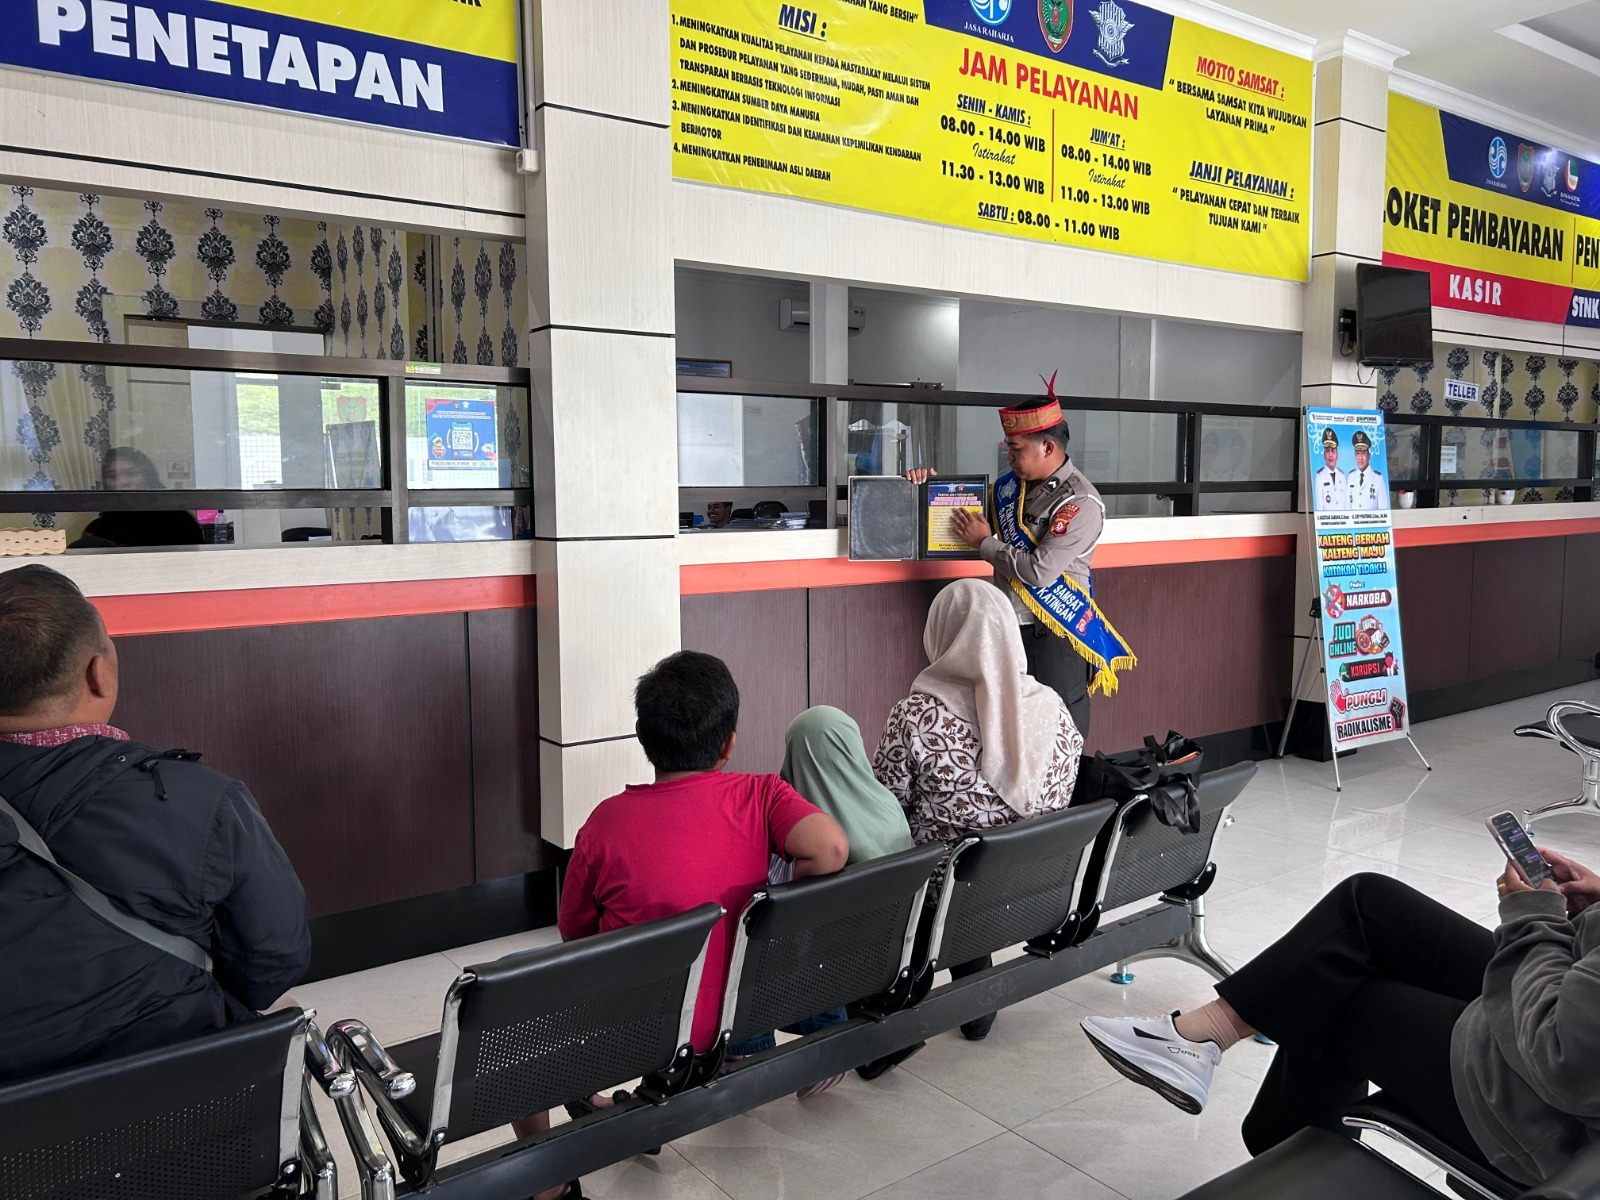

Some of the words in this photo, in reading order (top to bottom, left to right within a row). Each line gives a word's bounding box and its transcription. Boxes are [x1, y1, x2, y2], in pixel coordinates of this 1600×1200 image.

[778, 4, 817, 34] MISI
[868, 0, 888, 14] YANG
[964, 22, 981, 33] JASA
[982, 27, 1014, 43] RAHARJA
[37, 0, 444, 112] PENETAPAN
[680, 16, 740, 41] MENINGKATKAN
[742, 33, 773, 50] KUALITAS
[775, 43, 812, 60] PELAYANAN
[814, 54, 839, 69] KEPADA
[840, 60, 881, 80] MASYARAKAT
[883, 71, 908, 86] MELALUI
[910, 78, 930, 91] SISTEM
[680, 38, 696, 52] DAN
[698, 42, 737, 61] PROSEDUR
[739, 52, 778, 72] PELAYANAN
[780, 63, 798, 78] YANG
[800, 69, 840, 90] SEDERHANA,
[842, 80, 866, 96] MUDAH,
[868, 86, 884, 99] PASTI
[886, 91, 904, 104] AMAN
[906, 95, 919, 106] DAN
[680, 59, 729, 79] TRANSPARAN
[731, 72, 763, 88] BERBASIS
[765, 80, 803, 98] TEKNOLOGI
[805, 92, 840, 107] INFORMASI
[958, 48, 1008, 86] JAM
[1016, 63, 1138, 120] PELAYANAN
[1196, 56, 1235, 83] MOTTO
[1237, 70, 1279, 95] SAMSAT
[680, 80, 740, 103] MENINGKATKAN
[742, 94, 769, 110] SUMBER
[771, 101, 788, 114] DAYA
[790, 106, 820, 122] MANUSIA
[957, 94, 986, 113] SENIN
[995, 104, 1025, 124] KAMIS
[1177, 81, 1215, 102] BERSAMA
[1217, 93, 1246, 111] SAMSAT
[1248, 101, 1265, 117] KITA
[1267, 107, 1306, 128] WUJUDKAN
[681, 101, 740, 123] MENINGKATKAN
[743, 114, 786, 133] IDENTIFIKASI
[788, 125, 802, 137] DAN
[804, 128, 840, 145] KEAMANAN
[842, 137, 883, 154] KEPEMILIKAN
[885, 146, 921, 161] KENDARAAN
[681, 122, 722, 140] BERMOTOR
[941, 115, 975, 136] 08.00
[989, 126, 1020, 147] 14.00
[1024, 135, 1045, 152] WIB
[1206, 107, 1241, 128] LAYANAN
[1244, 118, 1268, 134] PRIMA
[682, 143, 741, 164] MENINGKATKAN
[743, 155, 787, 172] PENERIMAAN
[790, 164, 803, 176] ASLI
[806, 168, 830, 181] DAERAH
[972, 142, 1016, 165] Istirahat
[1061, 144, 1090, 163] 08.00
[1103, 153, 1129, 172] 14.00
[1133, 160, 1151, 176] WIB
[942, 160, 974, 181] 11.30
[989, 170, 1020, 190] 13.00
[1024, 177, 1045, 195] WIB
[1088, 168, 1125, 188] Istirahat
[1189, 161, 1222, 182] JANJI
[1225, 169, 1287, 197] PELAYANAN
[1061, 186, 1089, 204] 11.00
[1102, 194, 1128, 211] 13.00
[1132, 200, 1150, 215] WIB
[1180, 189, 1226, 209] PELAYANAN
[1229, 198, 1251, 214] CEPAT
[1253, 204, 1268, 218] DAN
[1271, 208, 1300, 224] TERBAIK
[978, 202, 1008, 220] SABTU
[1018, 209, 1050, 228] 08.00
[1064, 219, 1095, 236] 11.00
[1099, 224, 1120, 240] WIB
[1209, 213, 1238, 229] TUJUAN
[1241, 219, 1261, 233] KAMI
[1383, 187, 1441, 235] OKET
[1447, 202, 1564, 262] PEMBAYARAN
[1576, 234, 1600, 269] PEN
[1450, 274, 1502, 306] KASIR
[1572, 295, 1600, 319] STNK
[1448, 384, 1476, 400] TELLER
[1005, 502, 1019, 541] PEMANDU
[1318, 534, 1353, 547] KALTENG
[1355, 532, 1390, 546] BERKAH
[1323, 547, 1359, 560] KALTENG
[1360, 546, 1385, 558] MAJU
[1323, 564, 1356, 577] KATAKAN
[1037, 587, 1076, 622] KATINGAN
[1053, 584, 1084, 612] SAMSAT
[1346, 592, 1386, 607] NARKOBA
[1334, 624, 1355, 640] JUDI
[1330, 642, 1356, 656] ONLINE
[1350, 663, 1380, 677] KORUPSI
[1346, 689, 1386, 710] PUNGLI
[1337, 716, 1391, 739] RADIKALISME
